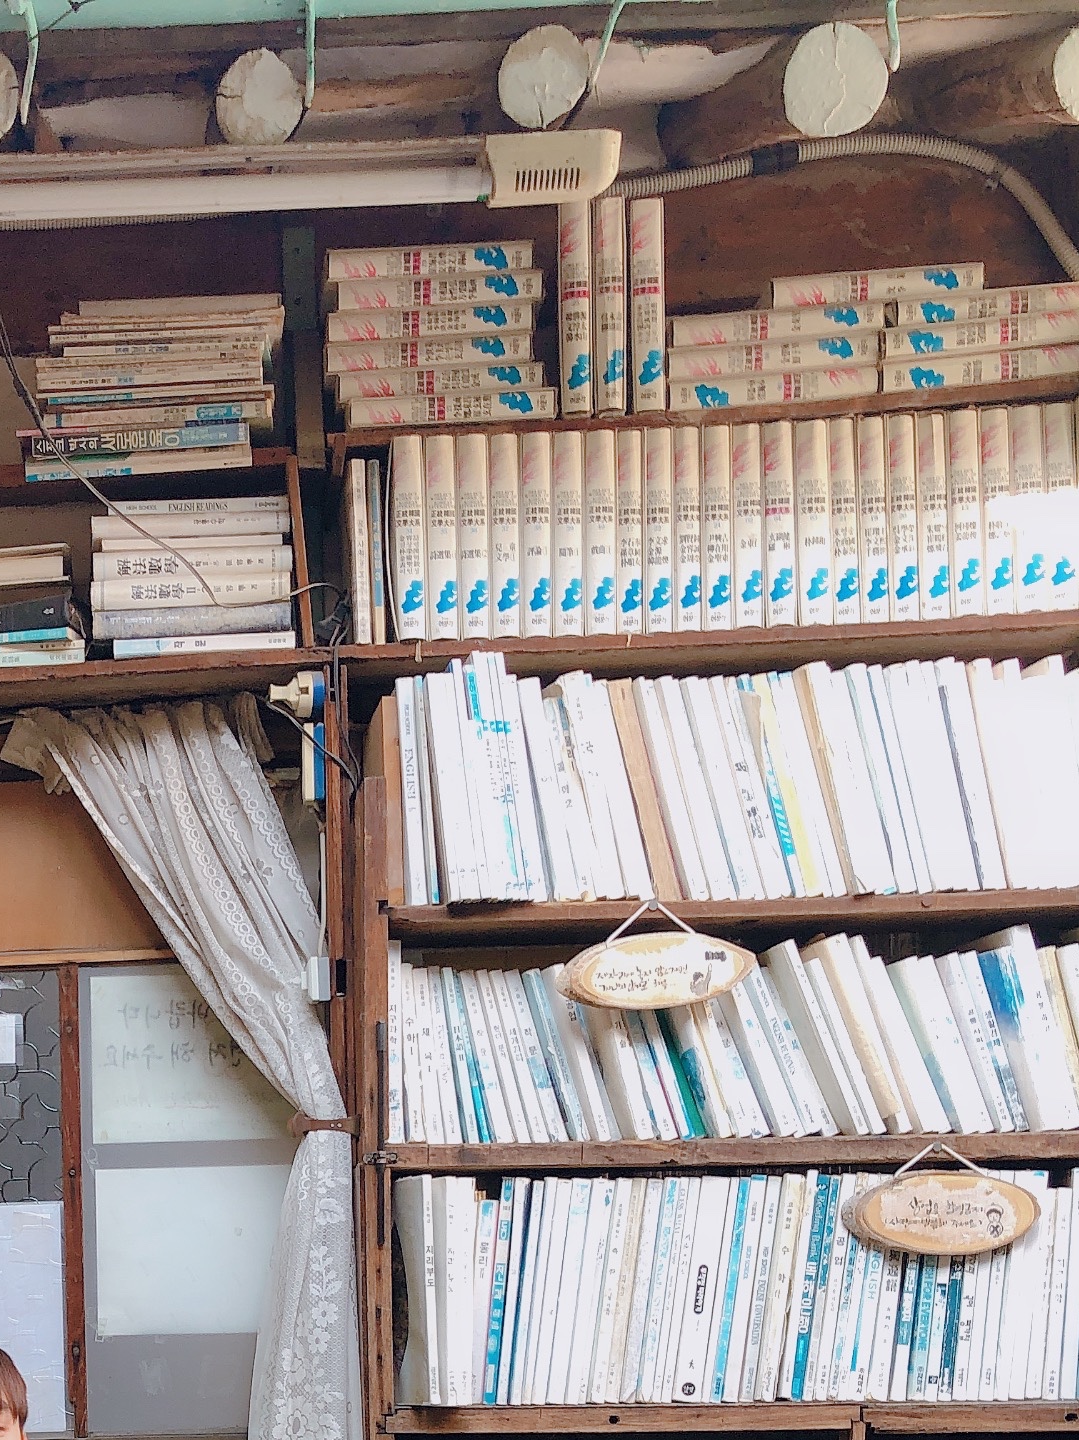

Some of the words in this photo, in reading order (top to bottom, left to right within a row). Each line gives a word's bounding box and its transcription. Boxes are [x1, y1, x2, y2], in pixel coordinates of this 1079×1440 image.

[168, 503, 194, 512] ENGLISH
[194, 501, 229, 511] READINGS
[405, 747, 417, 801] ENGLISH
